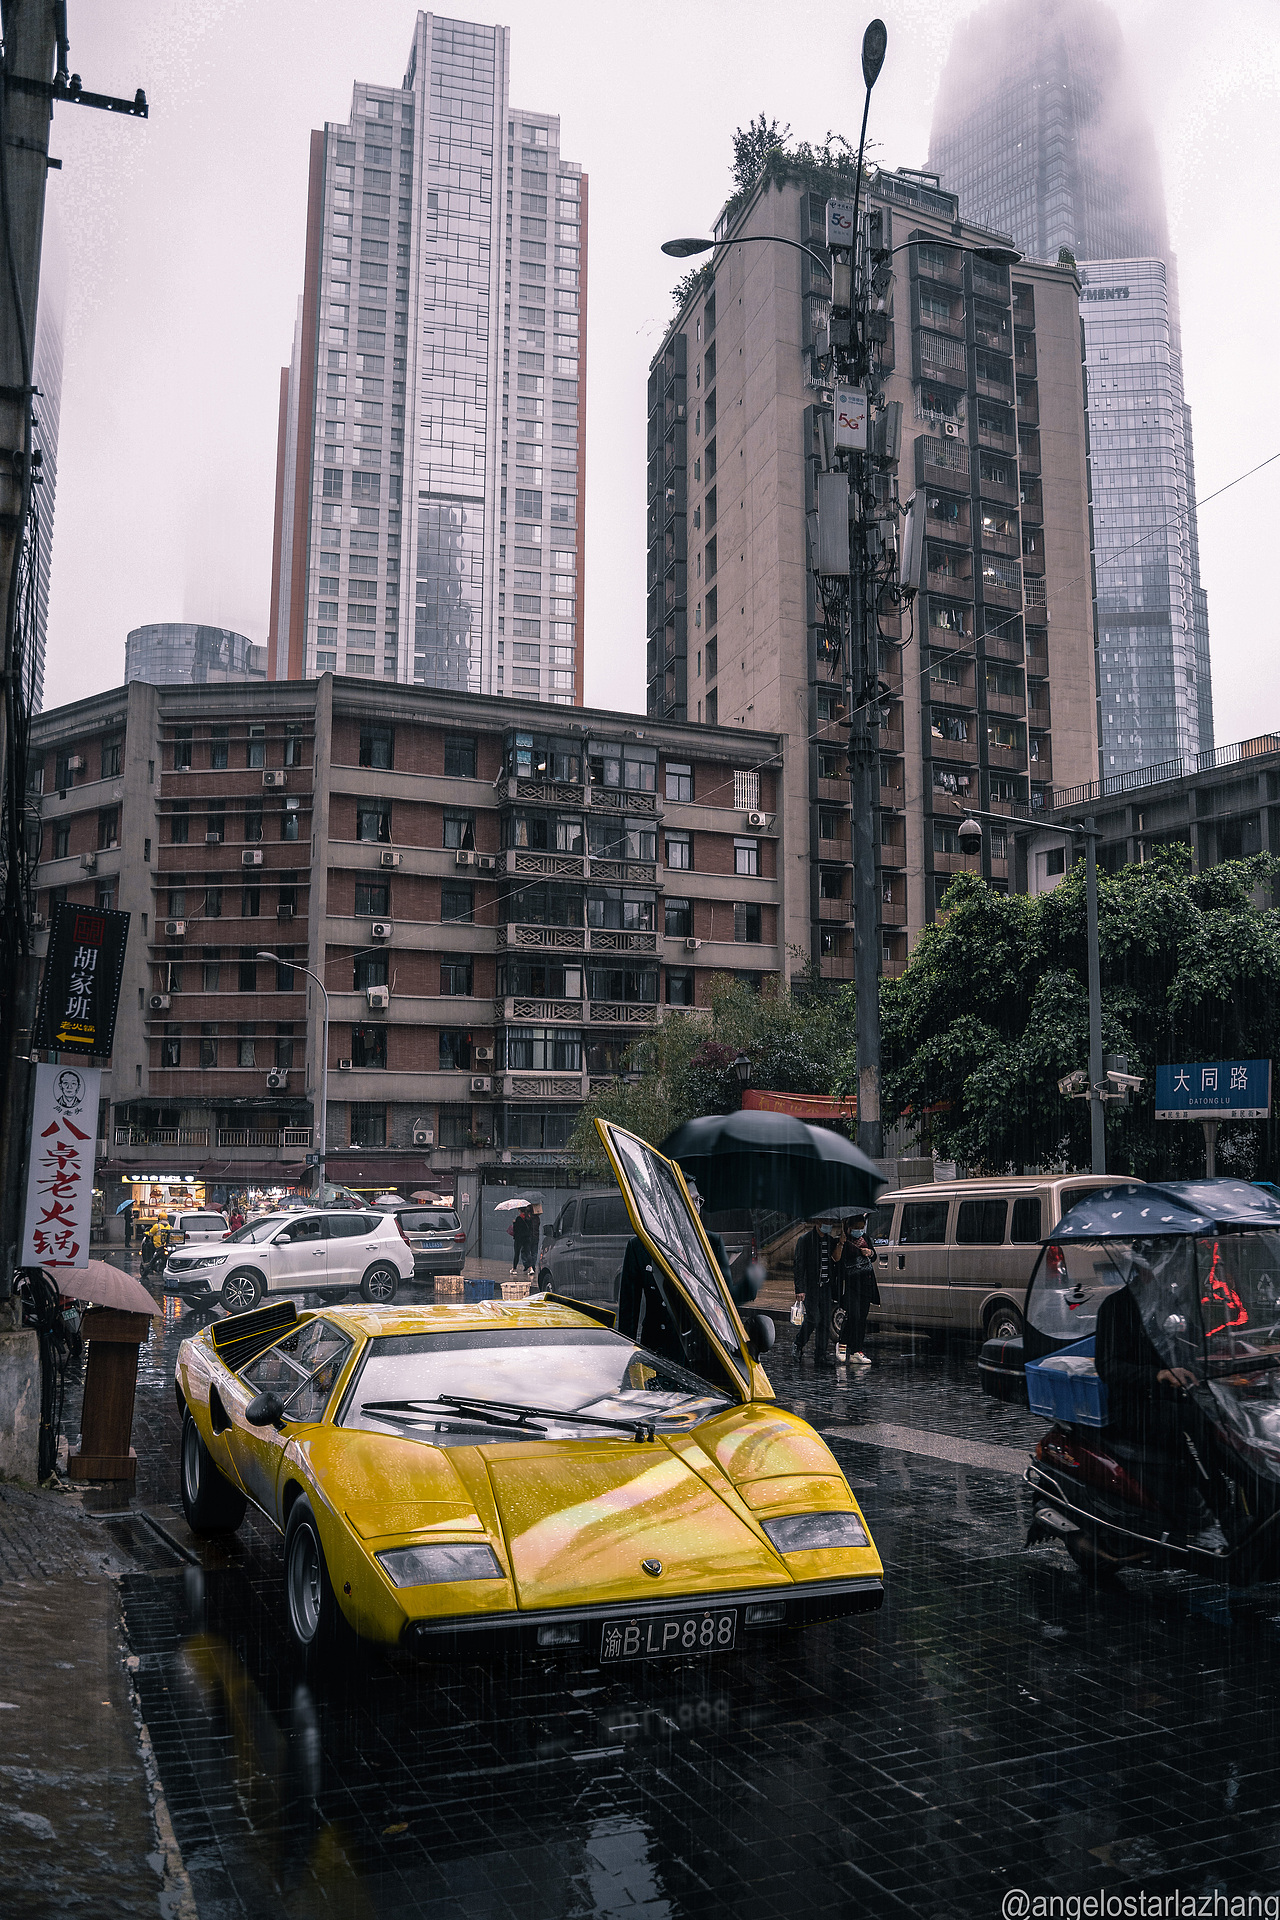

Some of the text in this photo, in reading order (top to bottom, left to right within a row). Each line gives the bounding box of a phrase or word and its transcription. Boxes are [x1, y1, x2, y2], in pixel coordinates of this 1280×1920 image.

[831, 213, 852, 229] 5G
[65, 946, 98, 1020] 胡家班
[60, 1021, 95, 1033] 老火锅
[1173, 1065, 1249, 1093] 大同路
[1189, 1097, 1219, 1105] DATONG
[33, 1116, 92, 1259] 八桌老火锅
